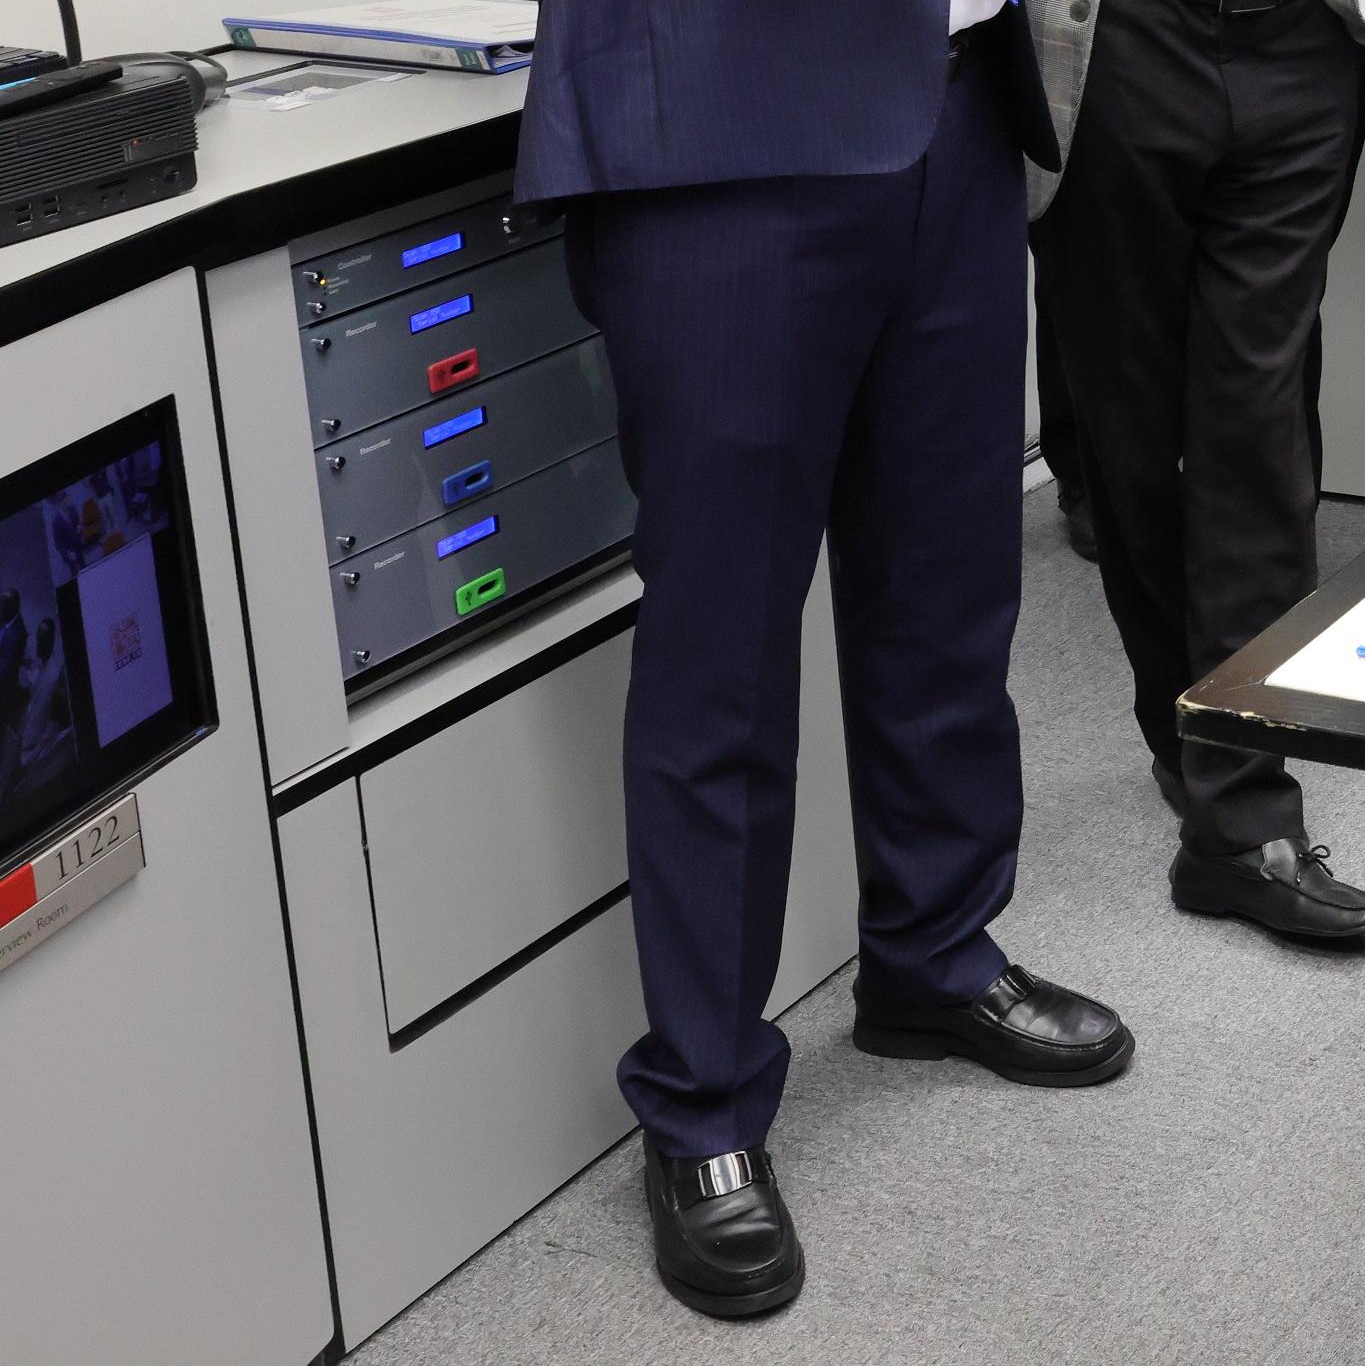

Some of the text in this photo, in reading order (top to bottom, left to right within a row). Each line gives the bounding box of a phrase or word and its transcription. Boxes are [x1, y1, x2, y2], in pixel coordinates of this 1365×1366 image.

[346, 322, 377, 338] Recorder
[359, 438, 391, 456] Recorder
[374, 551, 405, 569] Recorder
[55, 815, 120, 880] 1122
[36, 904, 69, 930] Room
